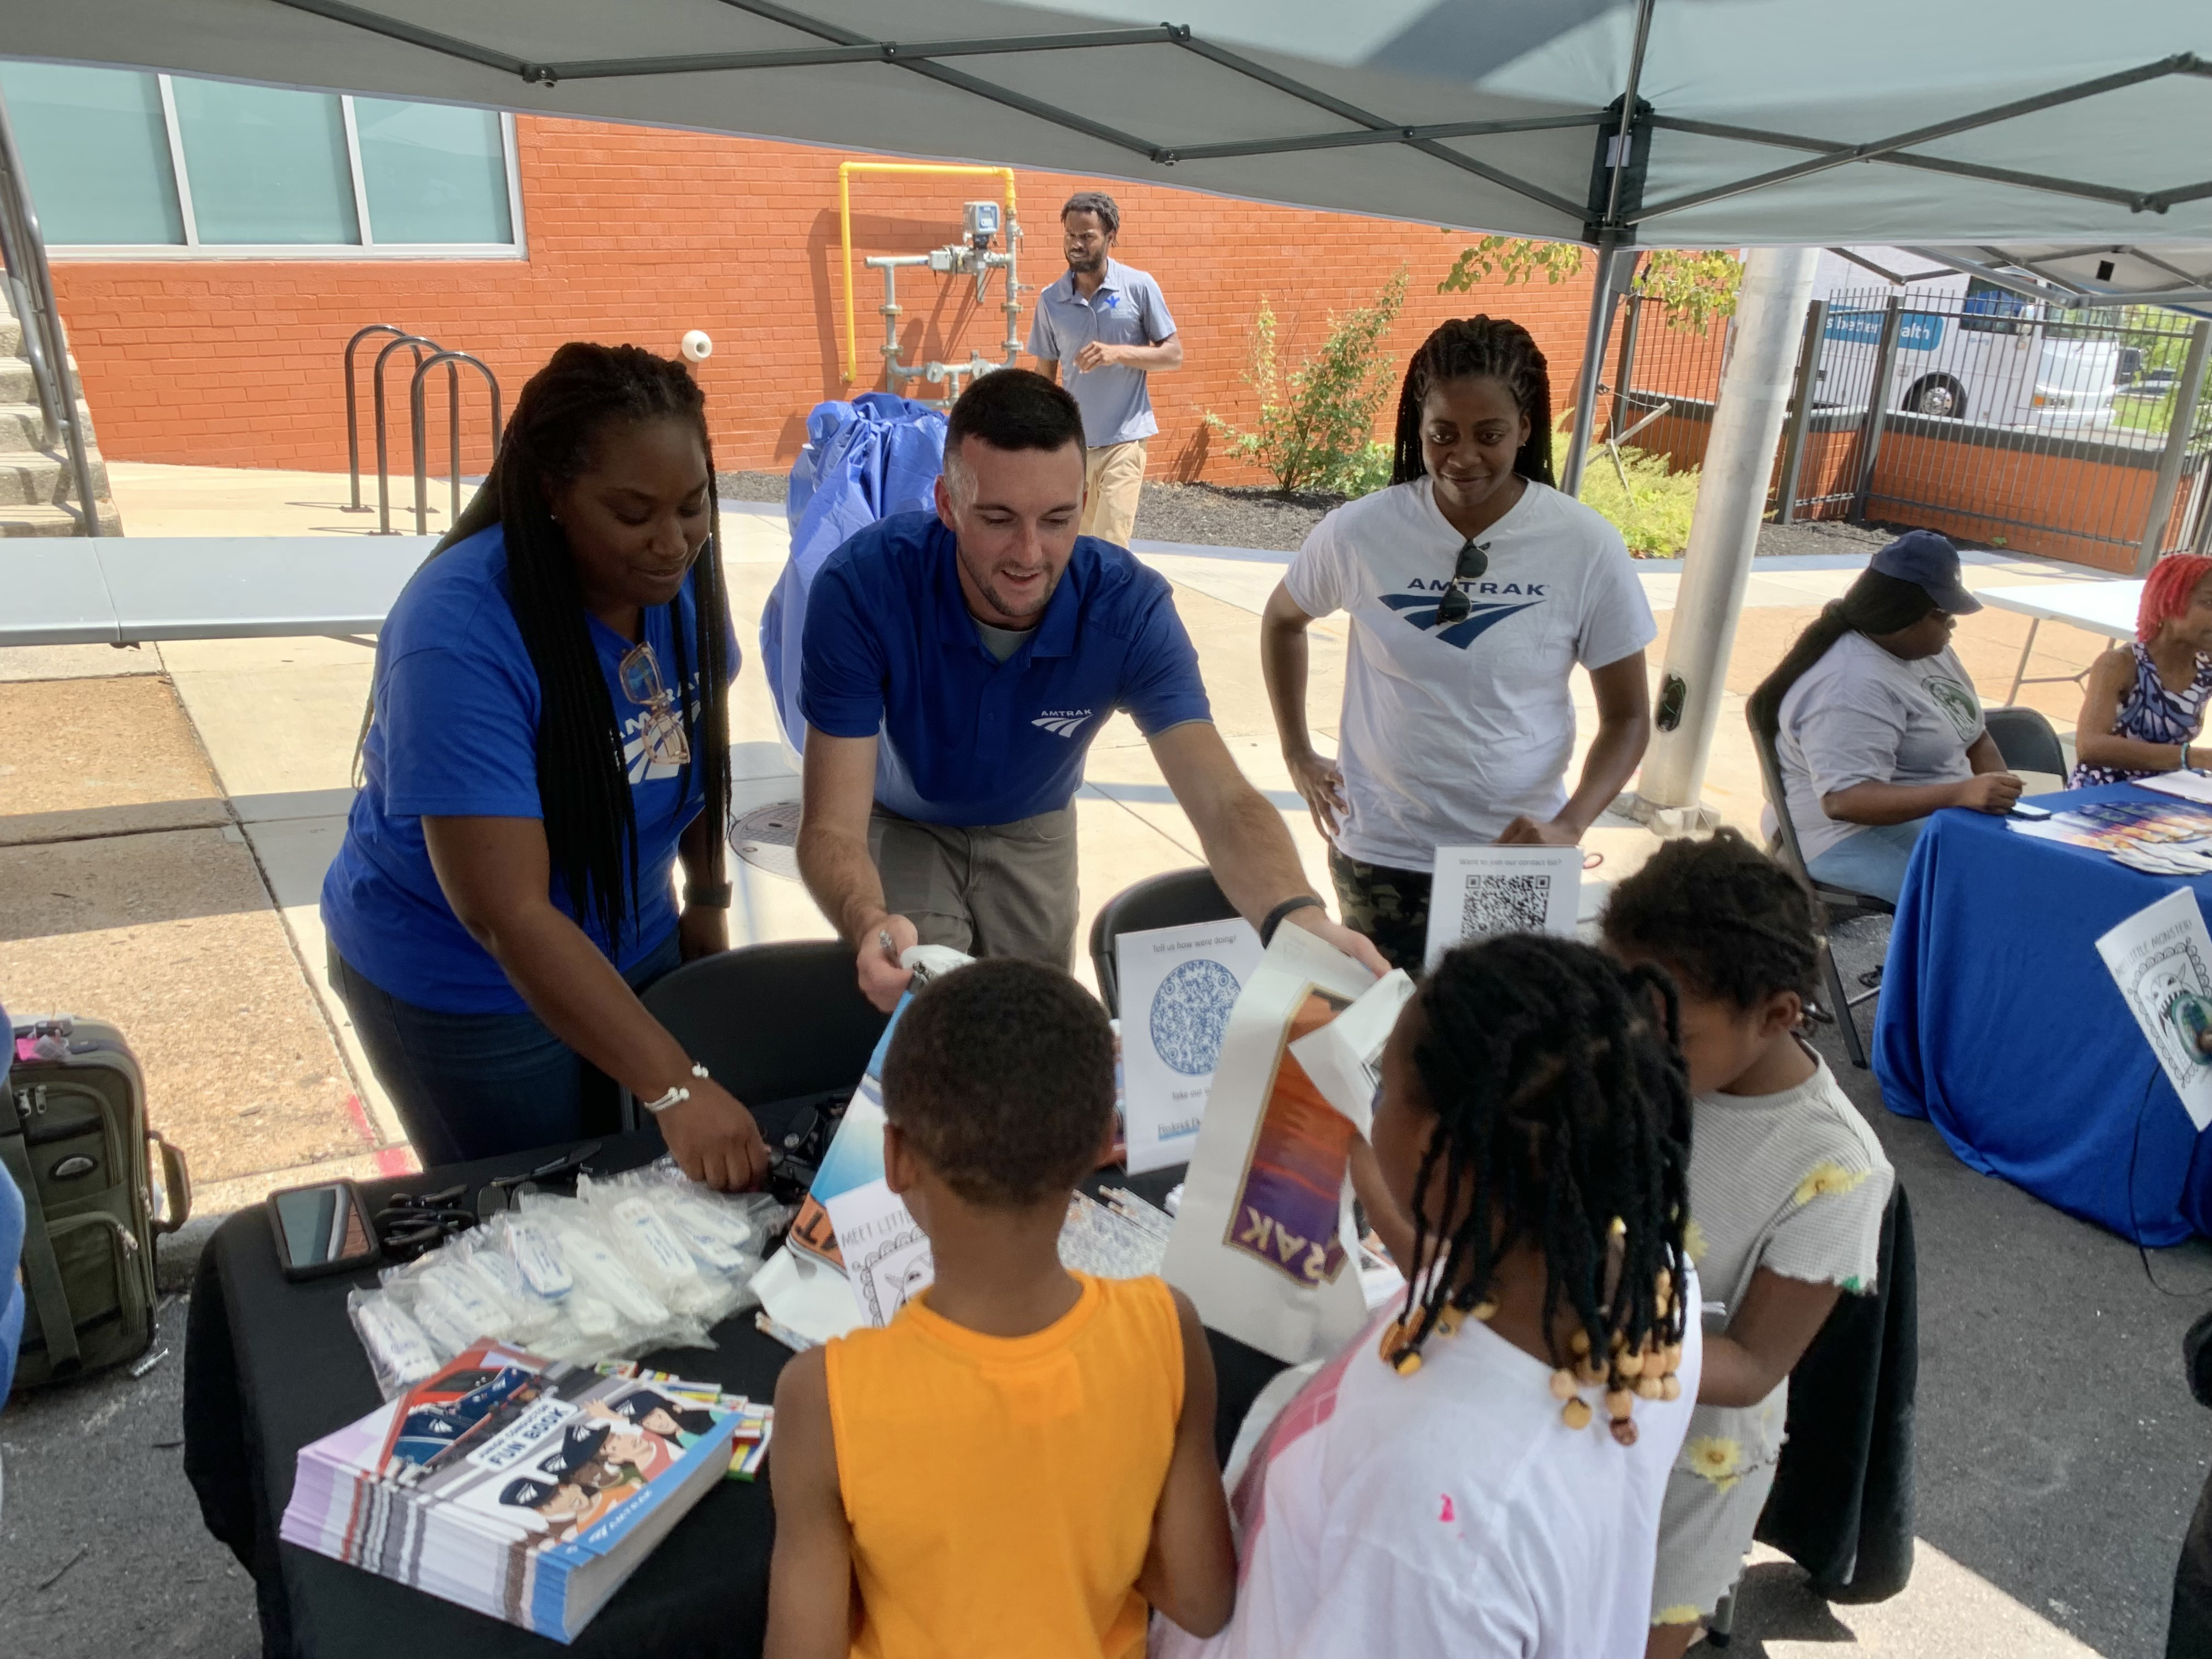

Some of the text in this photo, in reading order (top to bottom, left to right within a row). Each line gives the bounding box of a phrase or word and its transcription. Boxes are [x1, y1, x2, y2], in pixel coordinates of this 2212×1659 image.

[1836, 315, 1881, 334] better
[1901, 323, 1930, 340] alth
[1407, 578, 1545, 596] AMTRAK
[1041, 708, 1093, 717] AMTRAK
[1153, 943, 1165, 952] Tell
[1176, 941, 1193, 949] how
[1194, 939, 1212, 947] were
[1214, 934, 1237, 944] doing!
[1171, 1090, 1188, 1100] Take
[1189, 1088, 1202, 1097] our
[841, 1222, 873, 1249] MEET
[488, 1406, 563, 1465] FUN BOOK
